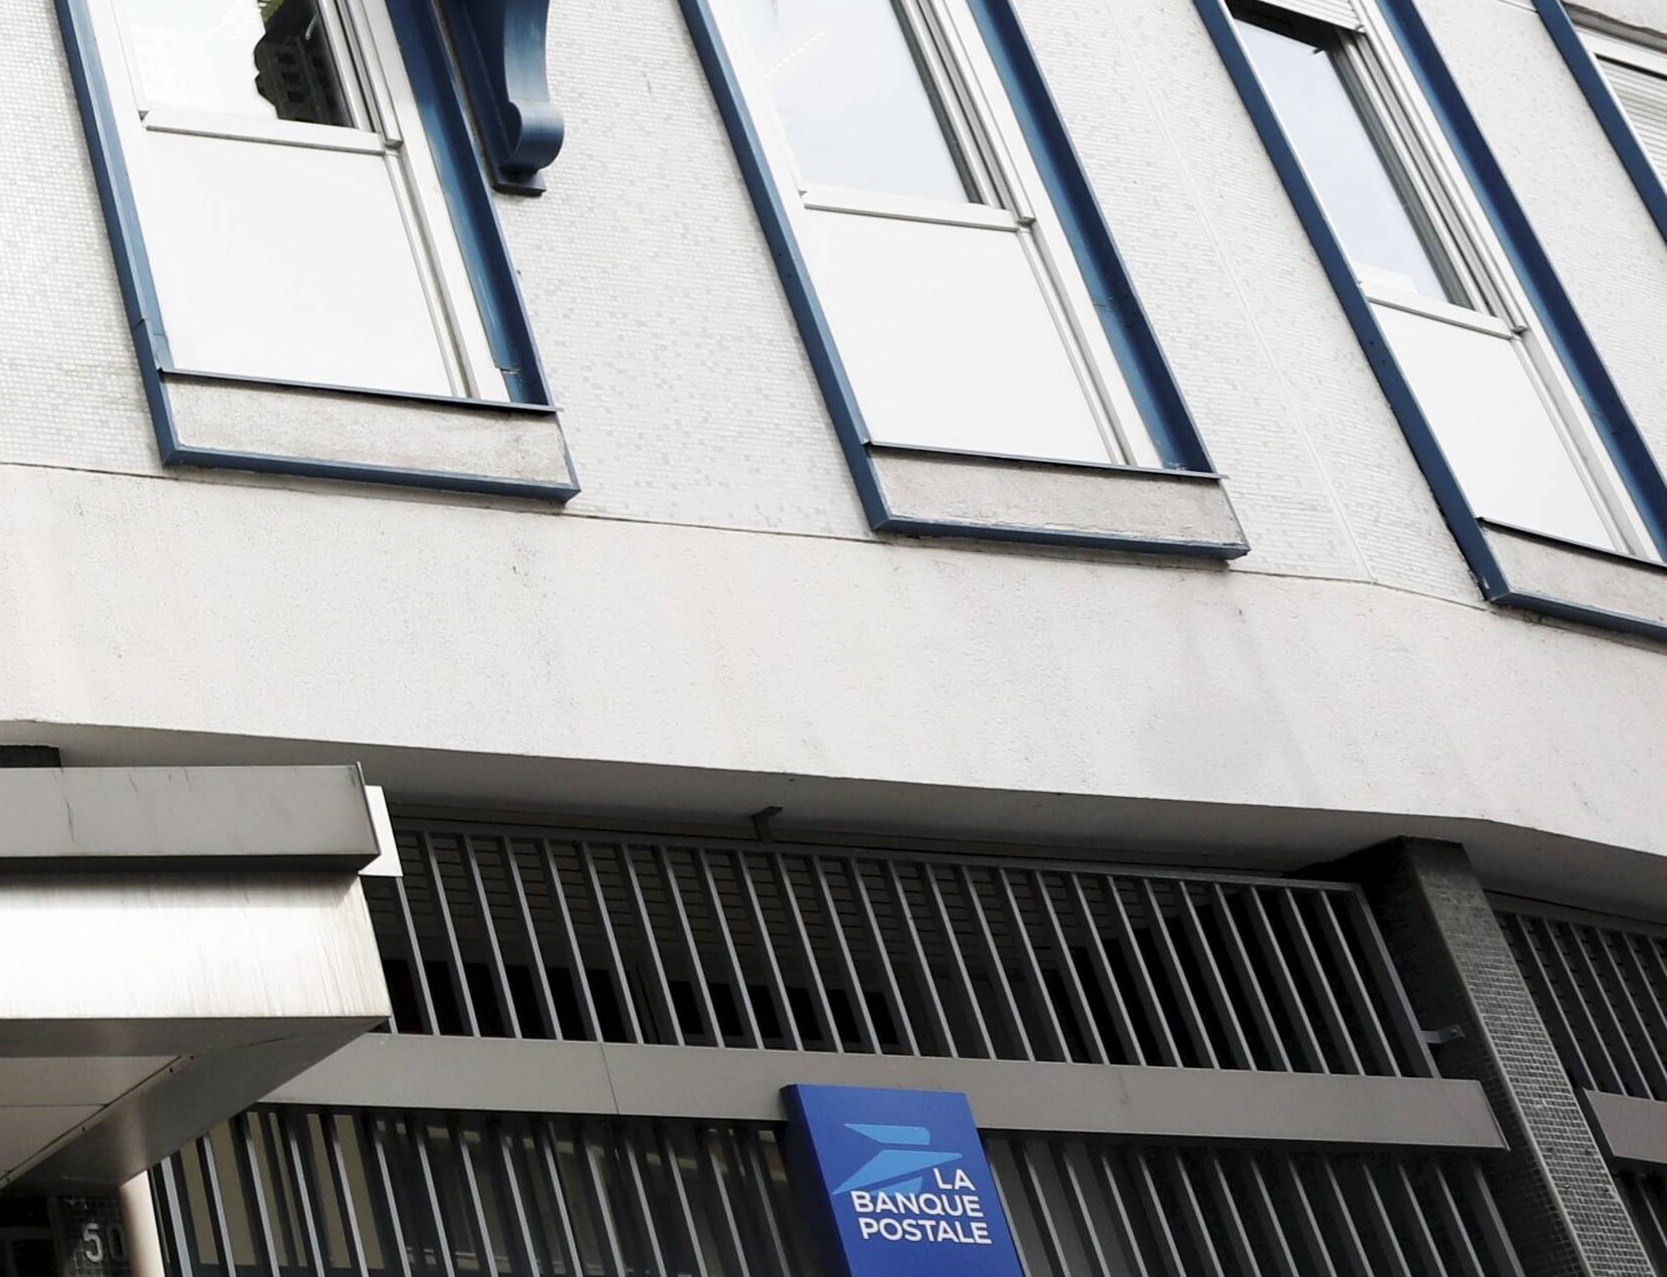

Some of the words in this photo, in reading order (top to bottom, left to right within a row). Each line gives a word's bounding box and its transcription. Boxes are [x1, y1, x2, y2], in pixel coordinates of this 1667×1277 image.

[933, 1167, 976, 1191] LA
[850, 1190, 984, 1218] BANQUE
[858, 1217, 993, 1245] POSTALE
